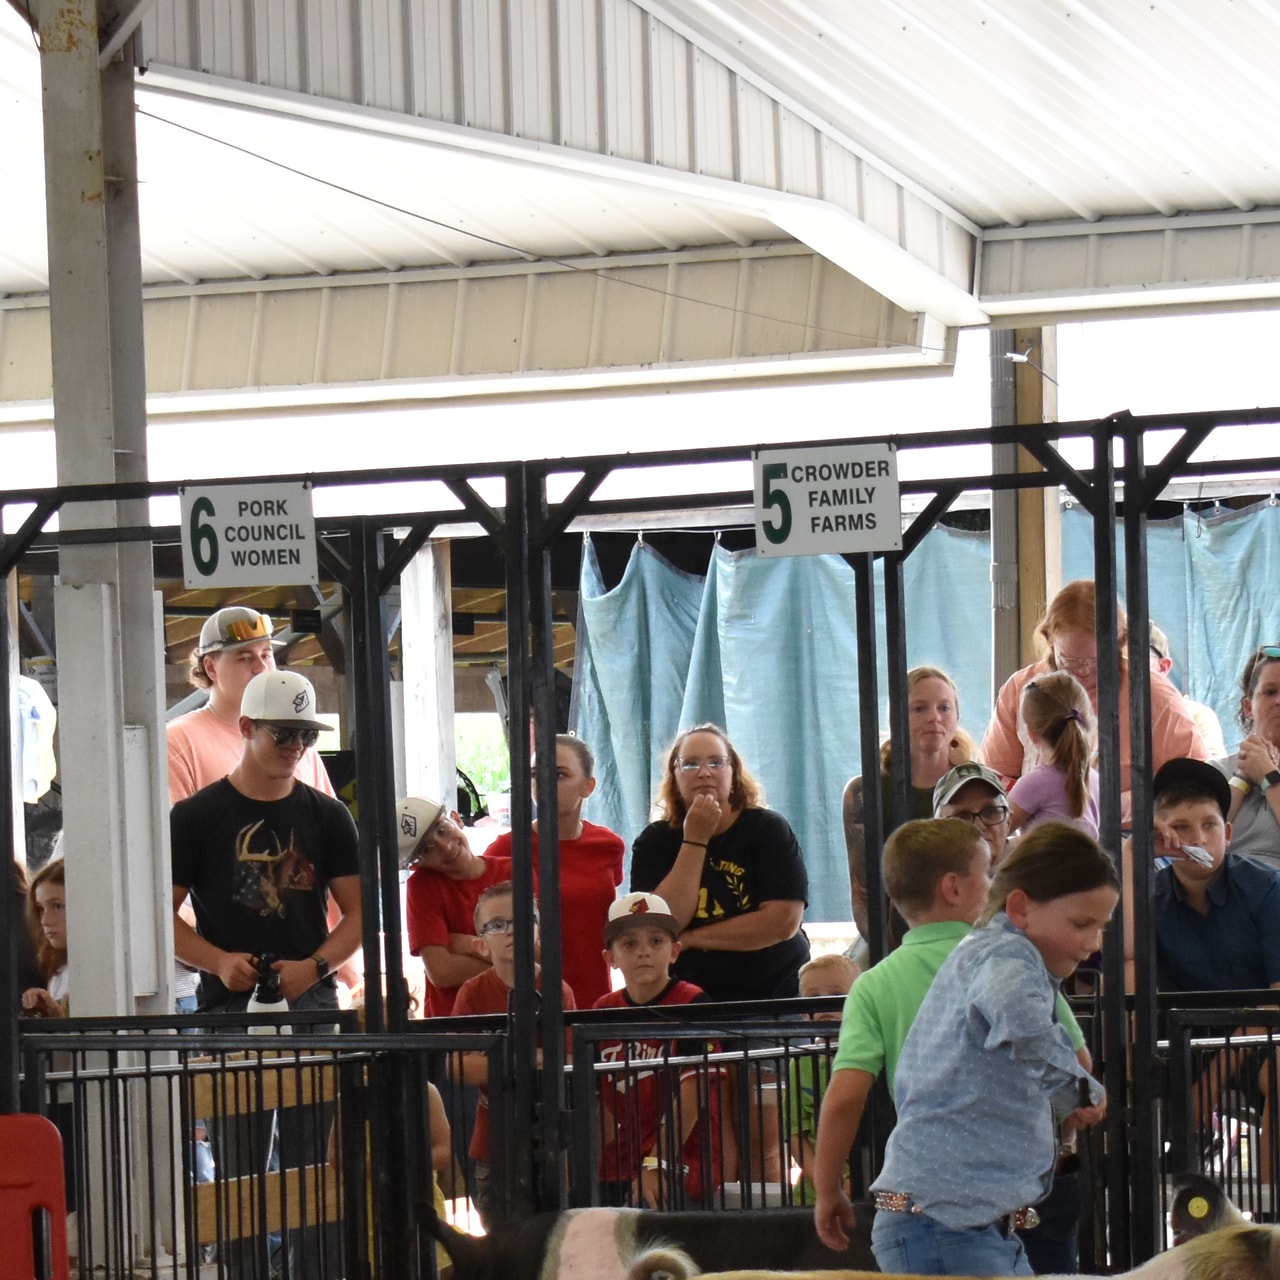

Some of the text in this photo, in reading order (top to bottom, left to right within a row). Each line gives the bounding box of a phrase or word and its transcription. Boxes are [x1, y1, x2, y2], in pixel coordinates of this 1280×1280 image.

[791, 460, 890, 483] CROWDER
[762, 463, 792, 545] 5
[808, 487, 876, 508] FAMILY
[238, 500, 288, 517] PORK
[224, 524, 306, 542] COUNCIL
[811, 513, 877, 533] FARMS
[190, 496, 219, 577] 6
[231, 548, 301, 567] WOMEN
